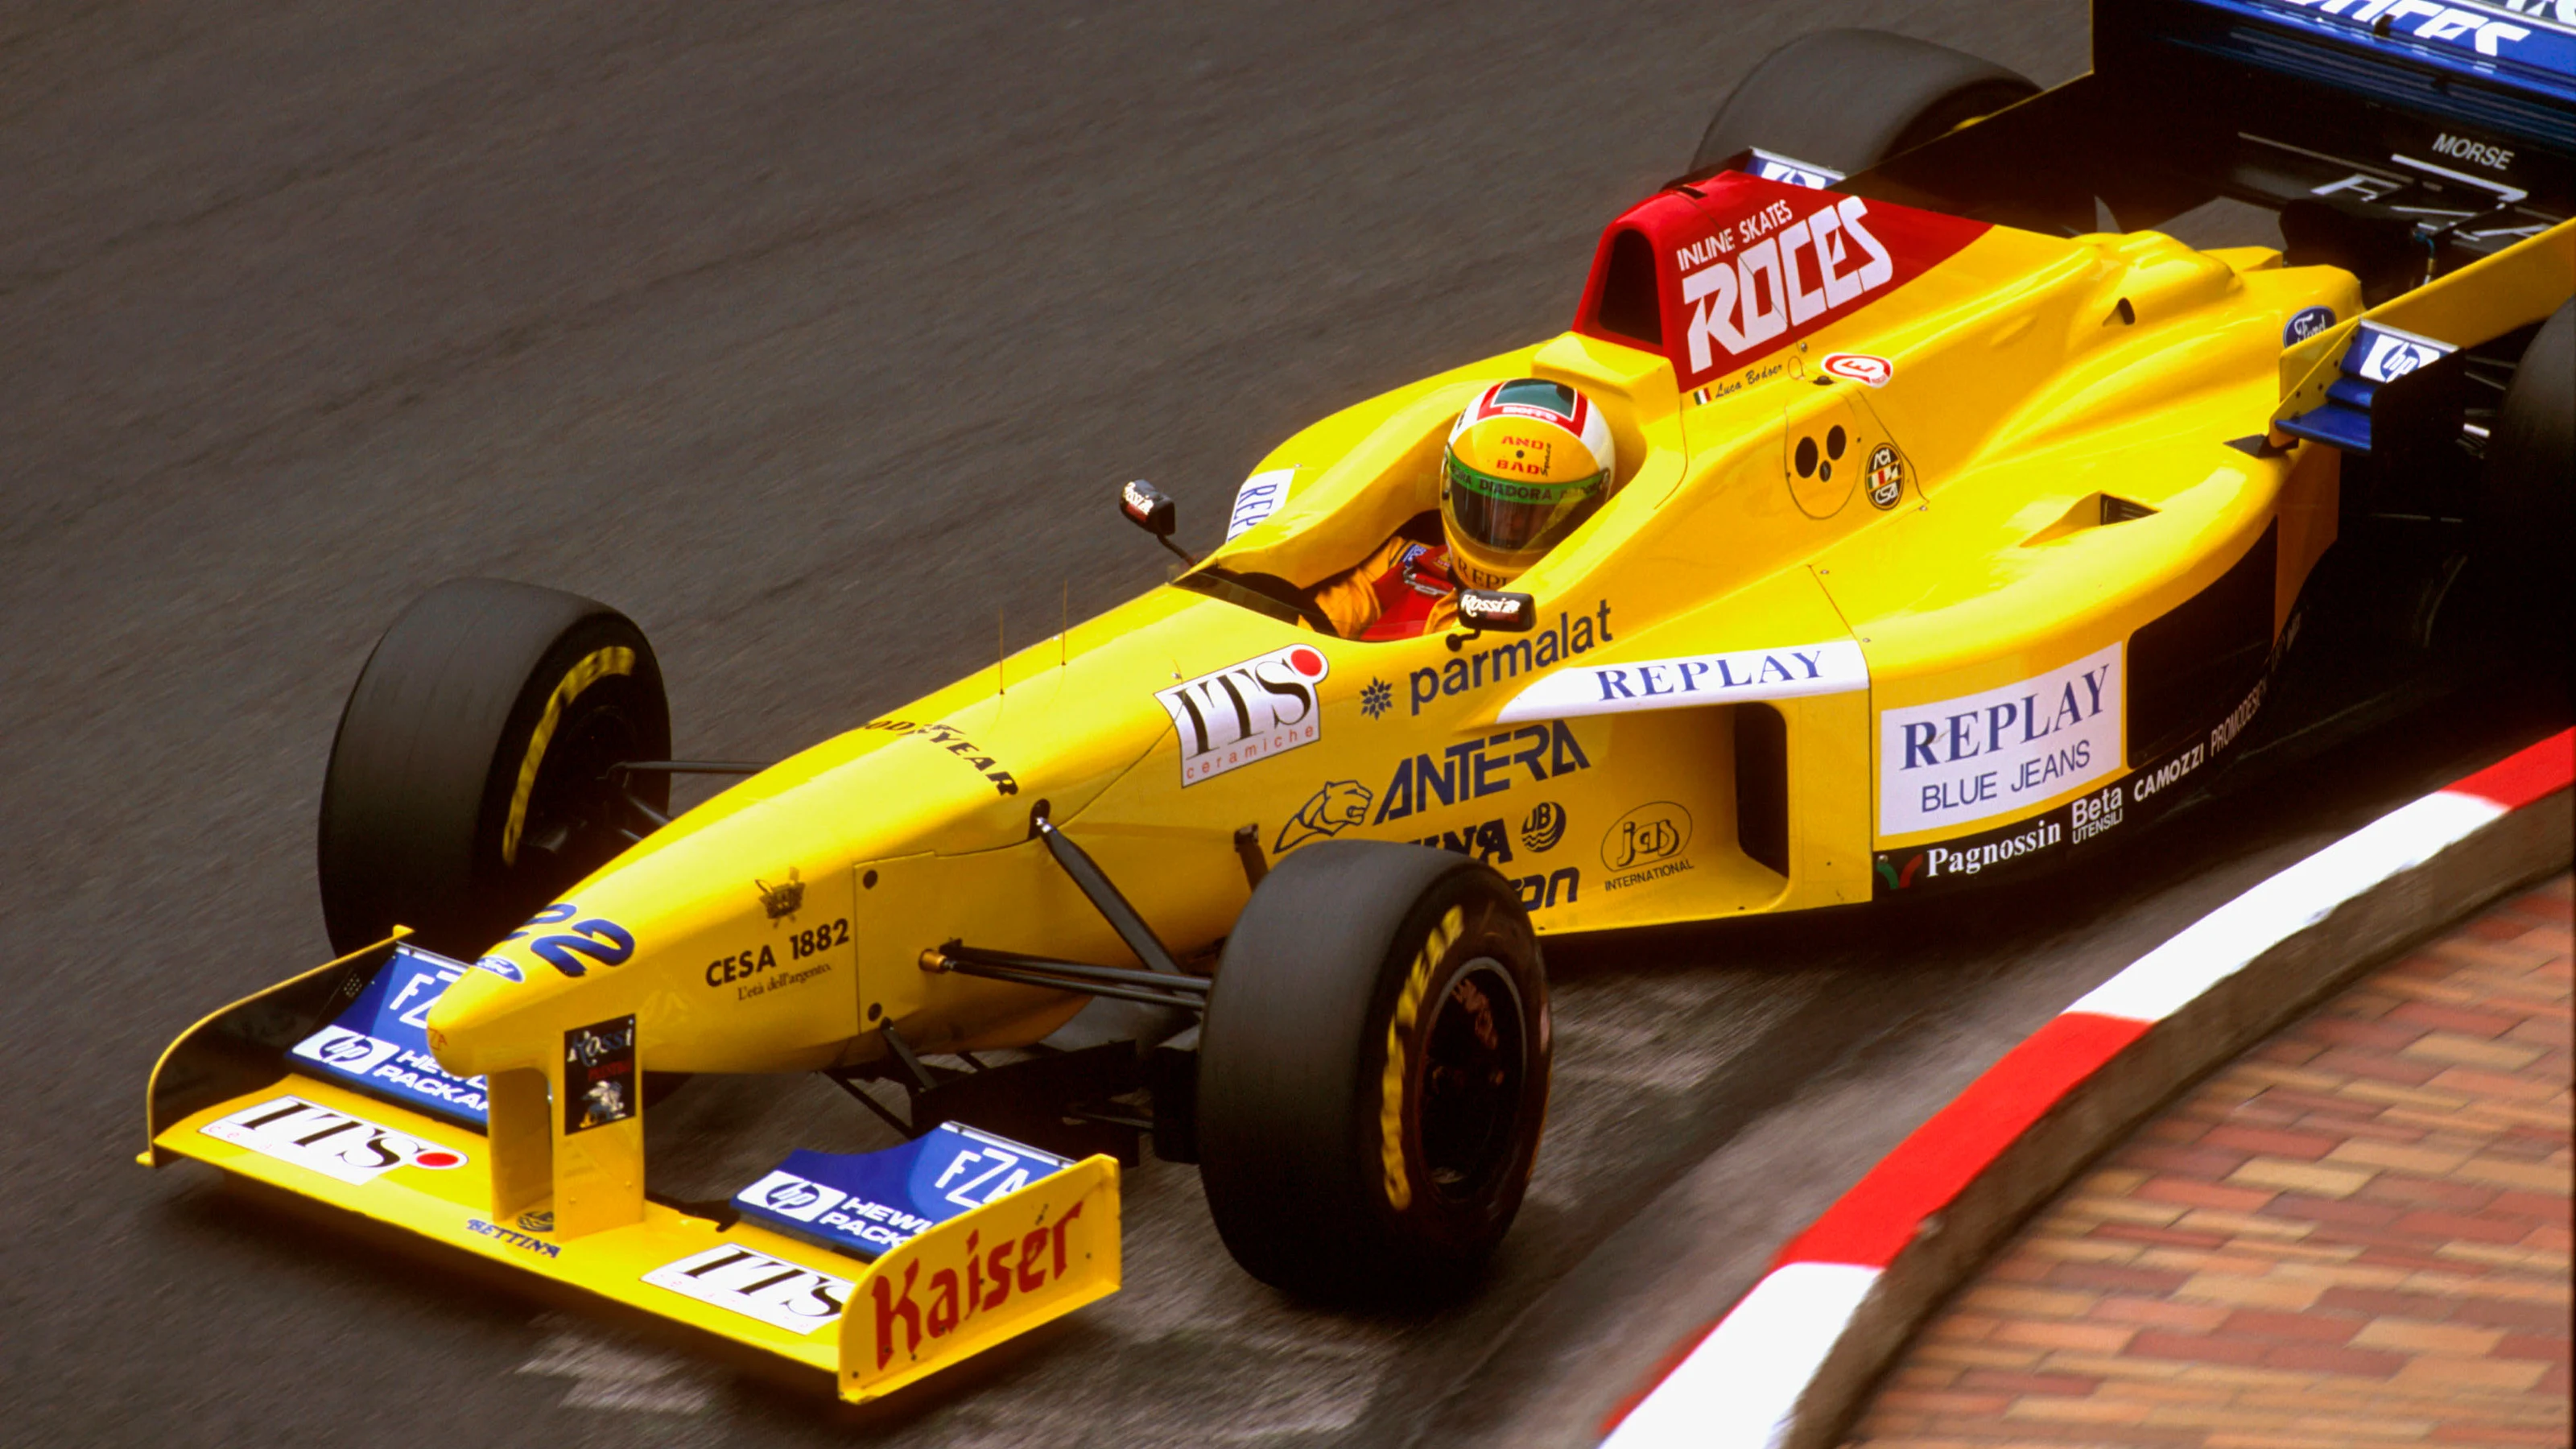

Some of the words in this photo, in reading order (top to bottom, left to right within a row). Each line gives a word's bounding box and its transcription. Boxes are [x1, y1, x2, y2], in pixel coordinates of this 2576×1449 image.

[2432, 134, 2515, 171] MORSE
[1677, 229, 1735, 272] INLINE
[1740, 199, 1793, 243] SKATES
[1682, 196, 1893, 374] ROCES
[2382, 341, 2418, 382] hp
[1715, 381, 1742, 398] Luca
[1479, 477, 1552, 501] DIADORA
[1496, 459, 1539, 475] BAD
[1461, 594, 1508, 617] Rossi
[1410, 598, 1614, 716] parmalat
[1594, 650, 1824, 701] REPLAY
[1171, 659, 1311, 760] ITS
[1900, 663, 2110, 770] REPLAY
[1186, 724, 1315, 780] ceramiche
[1373, 718, 1591, 826] ANTERA
[1922, 771, 1997, 813] BLUE
[2011, 740, 2091, 793] JEANS
[2134, 742, 2204, 802] CAMOZZI
[2071, 786, 2123, 829] Beta
[2073, 808, 2123, 844] UTENSILI
[1926, 819, 2062, 877] Pagnossin
[1604, 859, 1695, 892] INTERNATIONAL
[706, 945, 776, 988] CESA
[790, 919, 850, 960] 1882
[324, 1034, 370, 1063] hp
[567, 1018, 634, 1067] Rossi
[227, 1098, 427, 1167] ITS
[769, 1181, 816, 1209] hp
[935, 1148, 1029, 1208] FZA
[466, 1219, 561, 1258] BETTINA
[872, 1201, 1083, 1371] Kaiser
